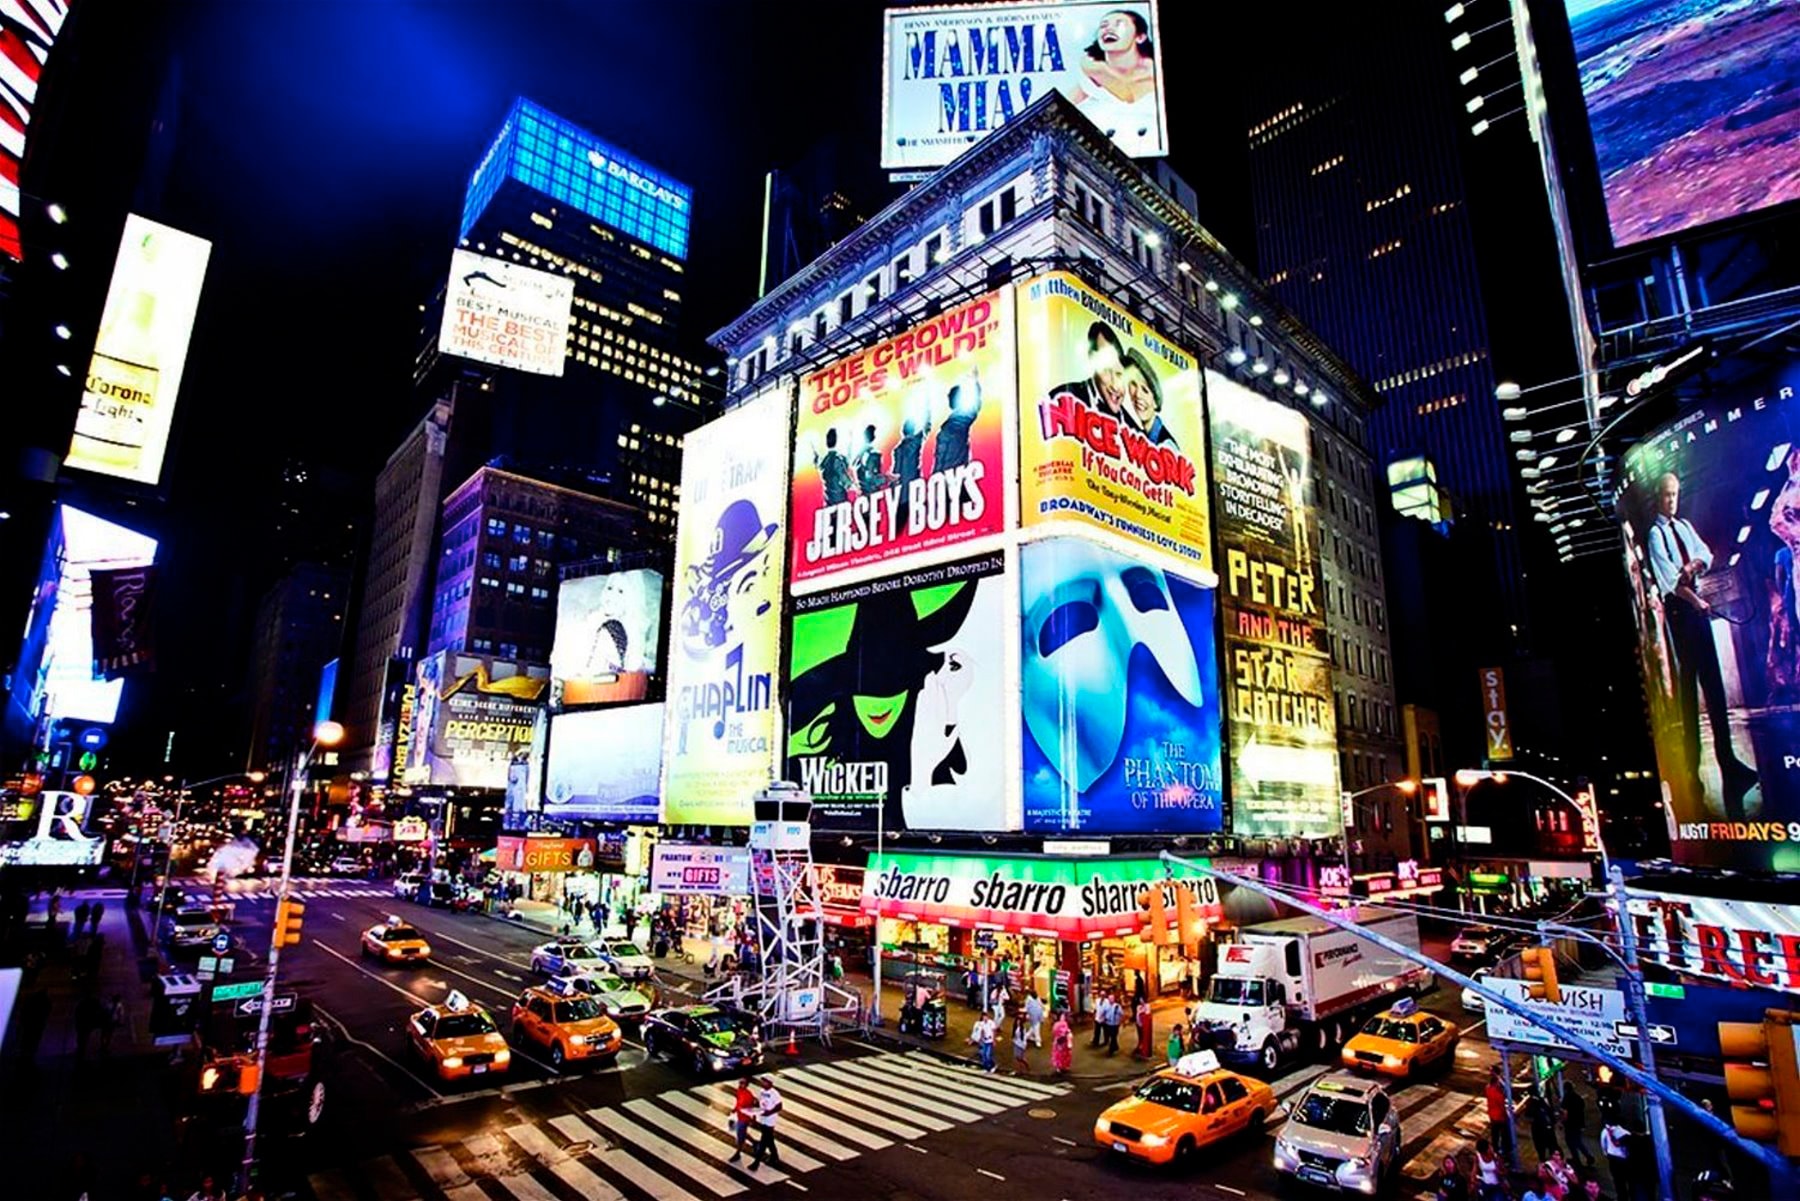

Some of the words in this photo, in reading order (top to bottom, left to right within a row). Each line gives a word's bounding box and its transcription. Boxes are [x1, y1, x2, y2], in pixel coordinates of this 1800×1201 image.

[903, 23, 1066, 80] MAMMA
[938, 77, 1032, 133] MIA!
[607, 160, 684, 209] BARCLAYS
[456, 296, 491, 311] BEST
[497, 306, 561, 330] MUSICAL
[457, 308, 499, 331] THE
[504, 320, 559, 345] BEST
[872, 299, 991, 368] CROWD
[1080, 289, 1134, 337] BRODERICK
[453, 323, 527, 349] MUSICAL
[1039, 394, 1122, 459] NICE
[1119, 424, 1196, 497] WORK
[1096, 455, 1118, 483] You
[1119, 466, 1141, 492] Can
[1142, 483, 1163, 505] Get
[804, 485, 902, 564] JERSEY
[907, 461, 986, 537] BOYS
[1227, 548, 1317, 614] PETER
[1238, 611, 1273, 641] AND
[1278, 620, 1315, 650] THE
[398, 684, 417, 745] FUERZA
[1236, 689, 1333, 734] CATCHER
[1162, 741, 1185, 758] THE
[1124, 757, 1221, 792] PHANTOM
[28, 790, 101, 842] R
[1131, 791, 1149, 809] OF
[1176, 790, 1215, 810] OPERA
[1576, 791, 1599, 848] PARK
[1710, 821, 1786, 841] FRIDAYS
[525, 851, 572, 867] GIFTS
[685, 868, 718, 882] GIFTS
[822, 881, 863, 903] STEAKS
[873, 865, 950, 904] sbarro
[969, 872, 1066, 916] sbarro
